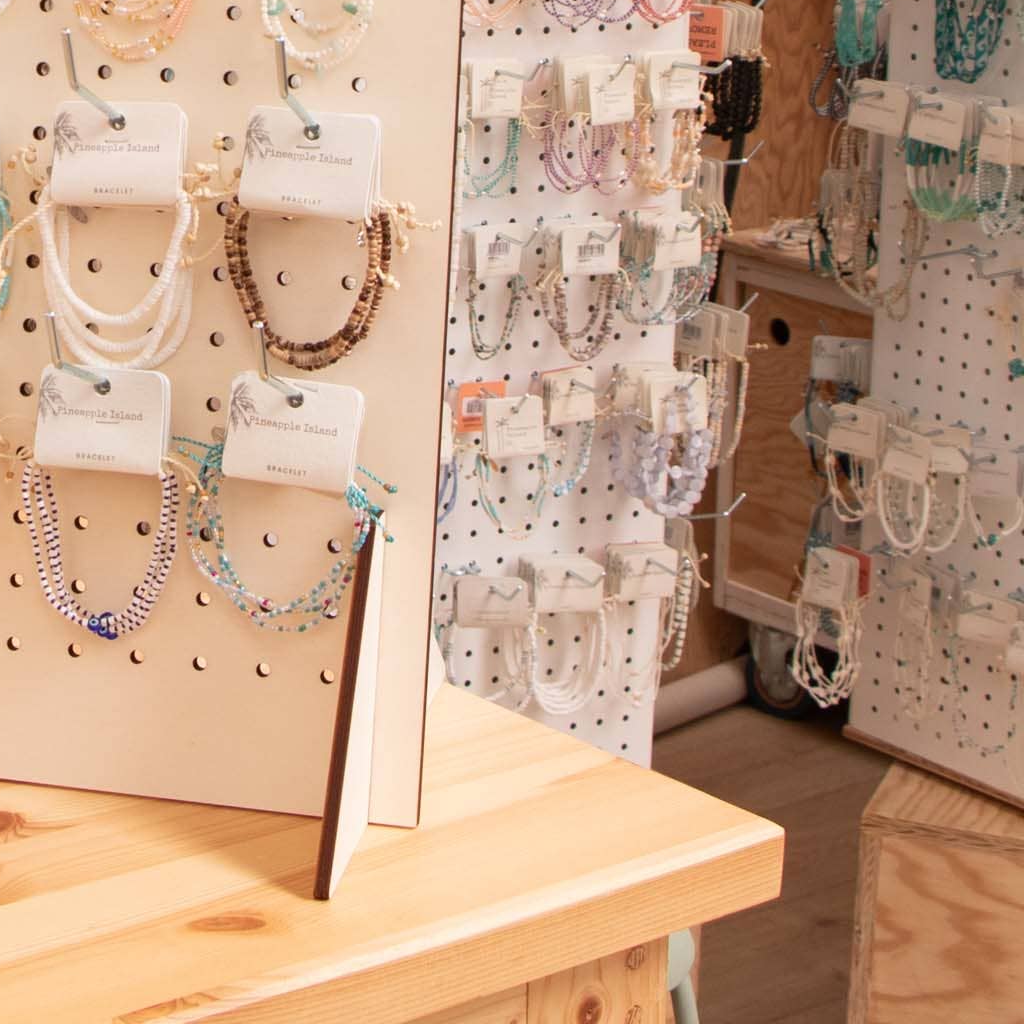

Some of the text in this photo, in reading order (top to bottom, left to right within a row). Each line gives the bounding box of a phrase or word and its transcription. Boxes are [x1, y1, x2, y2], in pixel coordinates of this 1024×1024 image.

[74, 143, 160, 154] Pineapple Island
[264, 147, 353, 166] Pineapple Island
[93, 186, 134, 196] BRACELET
[57, 406, 143, 422] Pineapple Island
[249, 415, 338, 437] Pineapple Island
[267, 464, 307, 477] BRACELET
